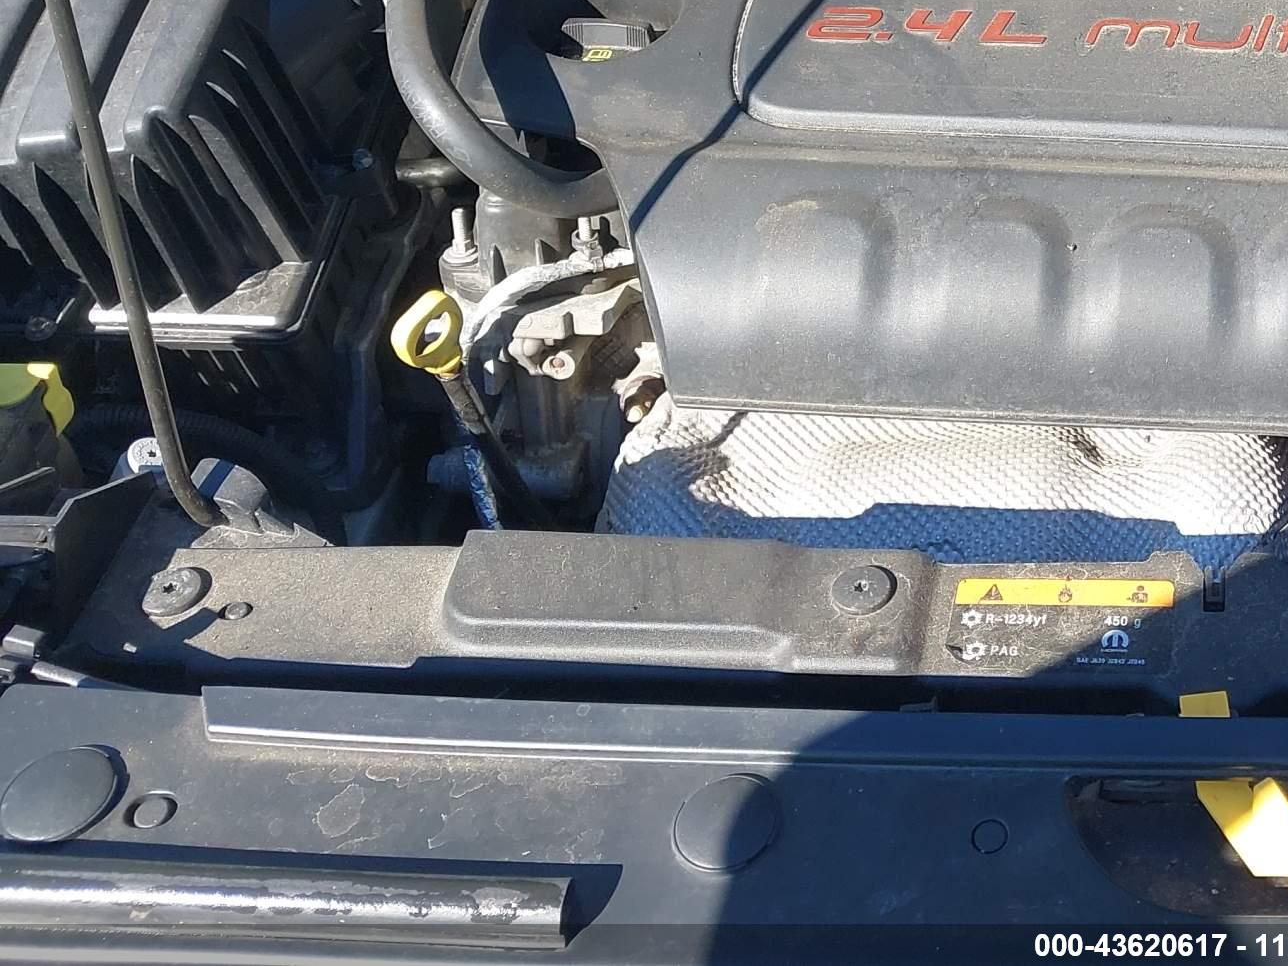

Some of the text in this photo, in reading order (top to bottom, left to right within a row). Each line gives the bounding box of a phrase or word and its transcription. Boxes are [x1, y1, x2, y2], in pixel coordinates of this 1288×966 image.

[985, 615, 1142, 629] R-1234yf 450 g
[990, 646, 1018, 657] PAG
